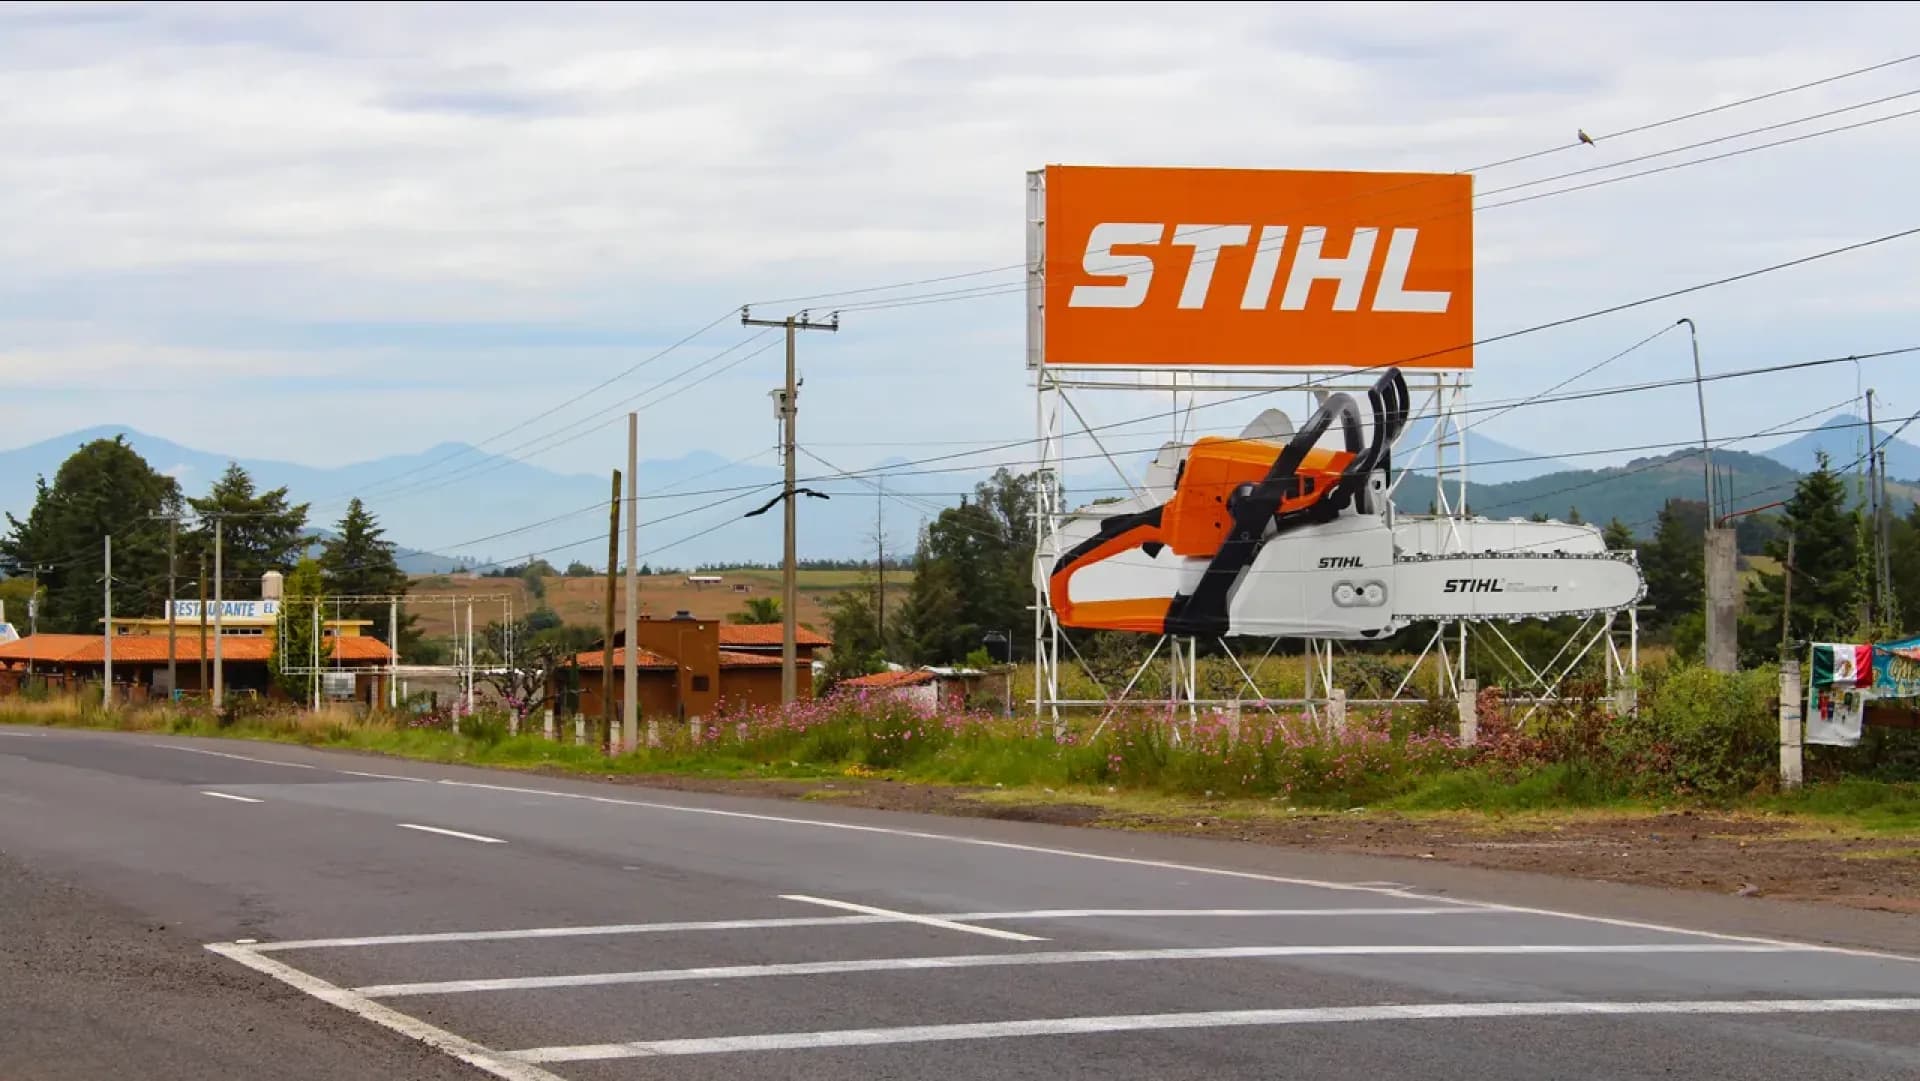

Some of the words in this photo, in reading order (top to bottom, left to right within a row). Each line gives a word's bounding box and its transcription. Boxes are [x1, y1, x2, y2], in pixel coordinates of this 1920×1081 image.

[1068, 222, 1452, 313] STIHL
[1318, 556, 1364, 568] STIHL
[1443, 578, 1504, 592] STIHL
